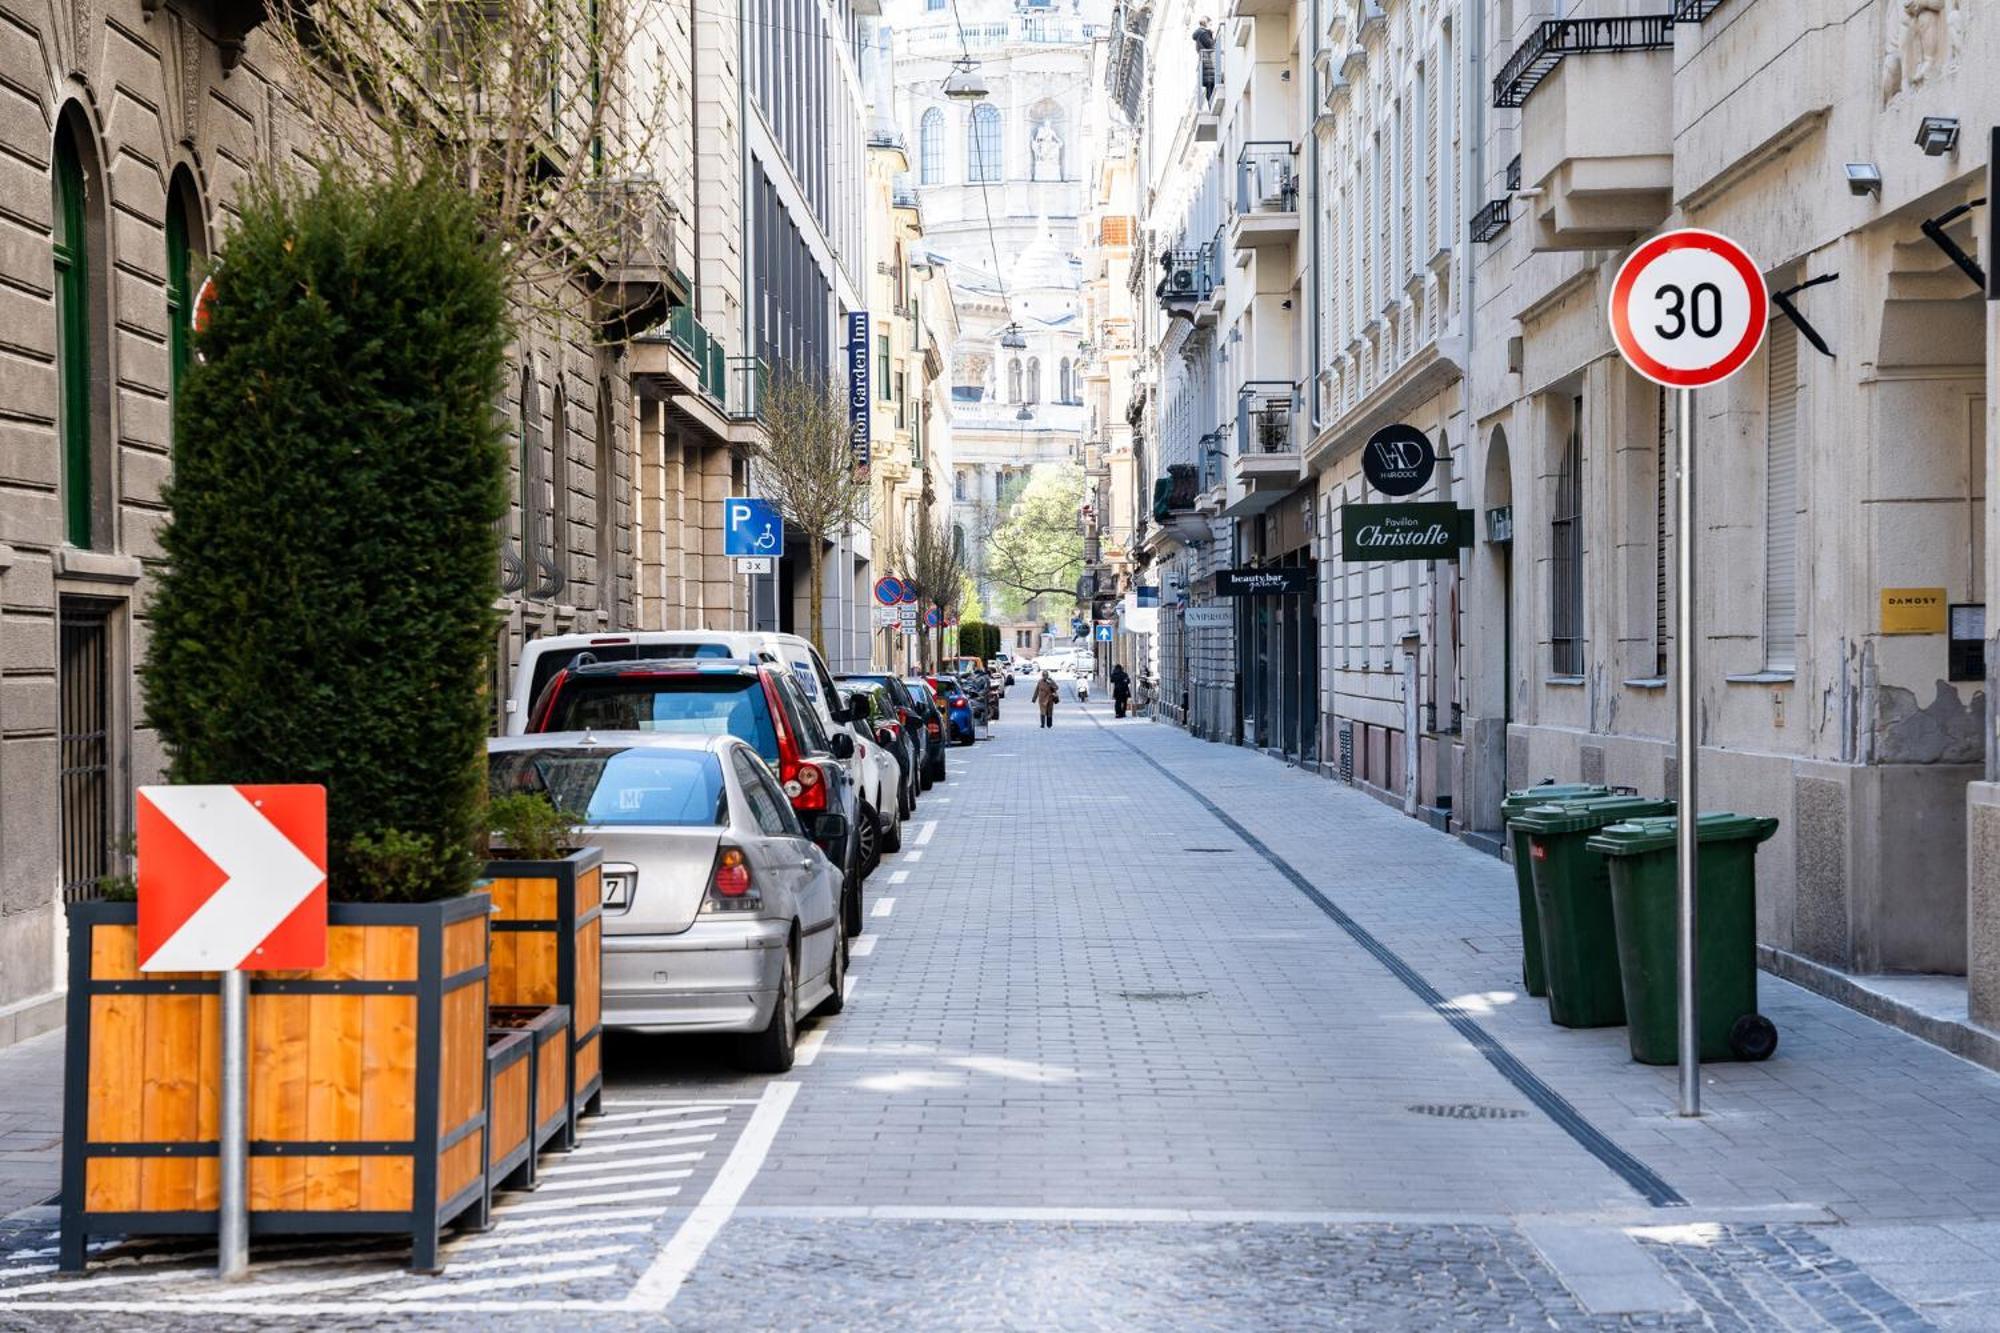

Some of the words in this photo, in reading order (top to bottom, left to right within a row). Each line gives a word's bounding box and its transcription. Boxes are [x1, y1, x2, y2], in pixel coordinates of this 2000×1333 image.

[1654, 282, 1723, 340] 30
[852, 314, 866, 344] Inn
[852, 347, 867, 408] Garden
[732, 505, 751, 532] P
[1355, 524, 1449, 547] Christofle
